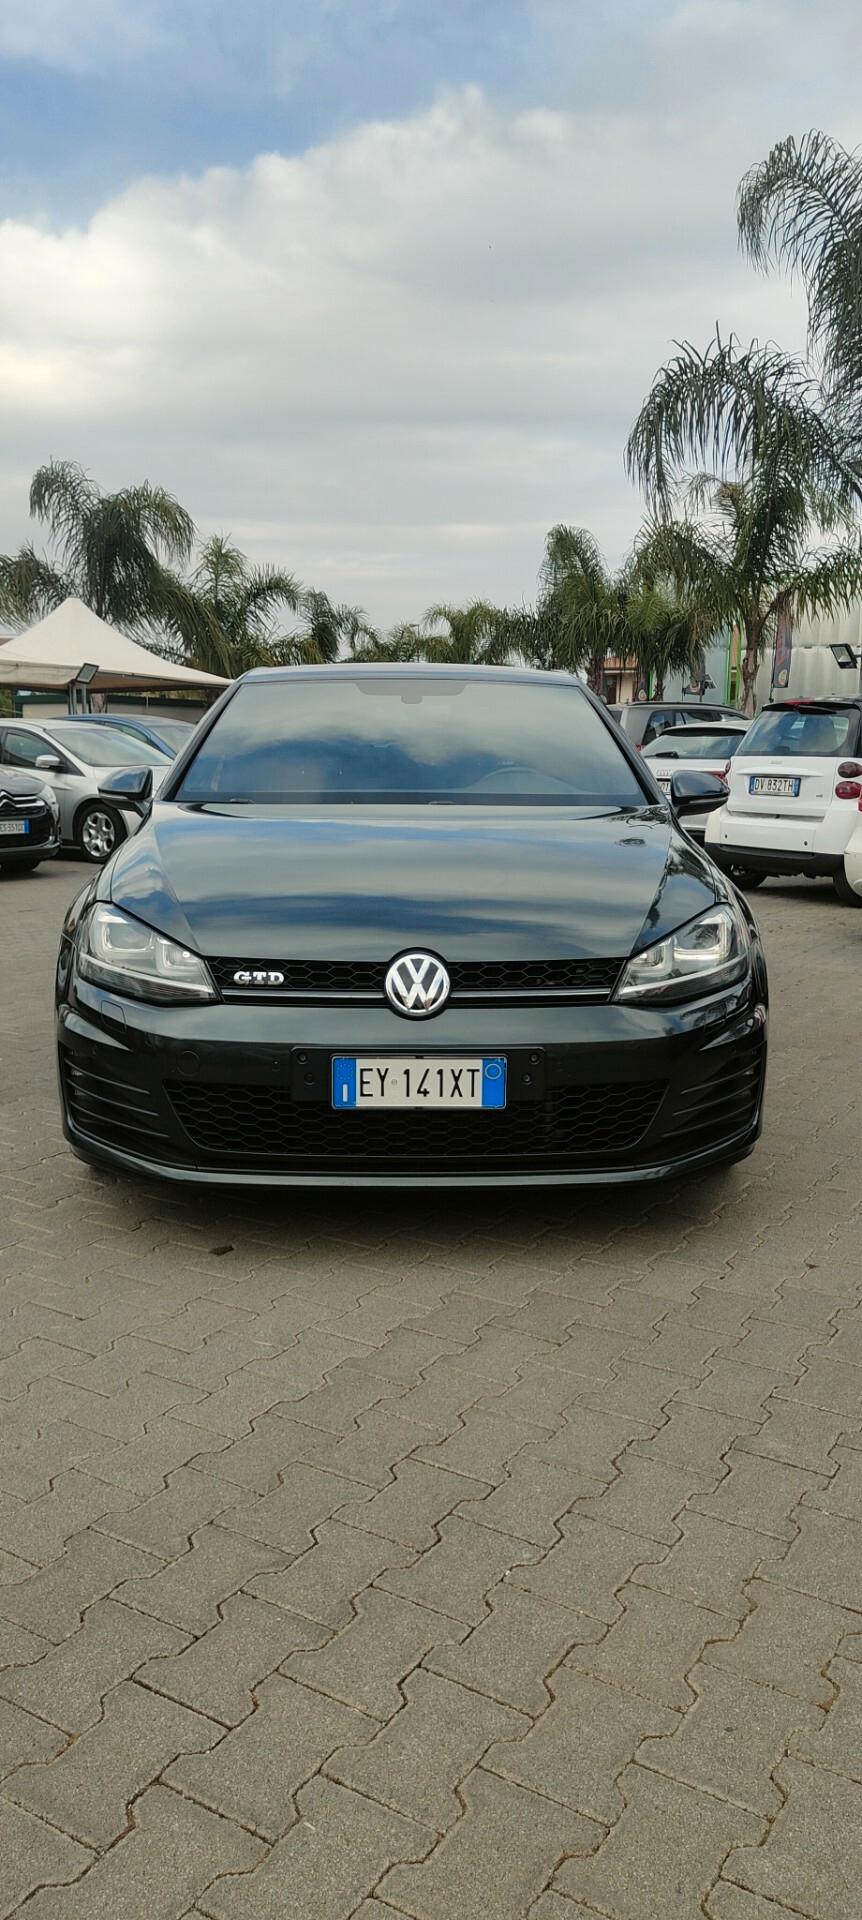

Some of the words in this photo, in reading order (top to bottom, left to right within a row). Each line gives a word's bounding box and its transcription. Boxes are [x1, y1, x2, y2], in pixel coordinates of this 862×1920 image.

[233, 971, 285, 985] GTD
[359, 1068, 389, 1097] EY
[403, 1068, 480, 1097] 141XT
